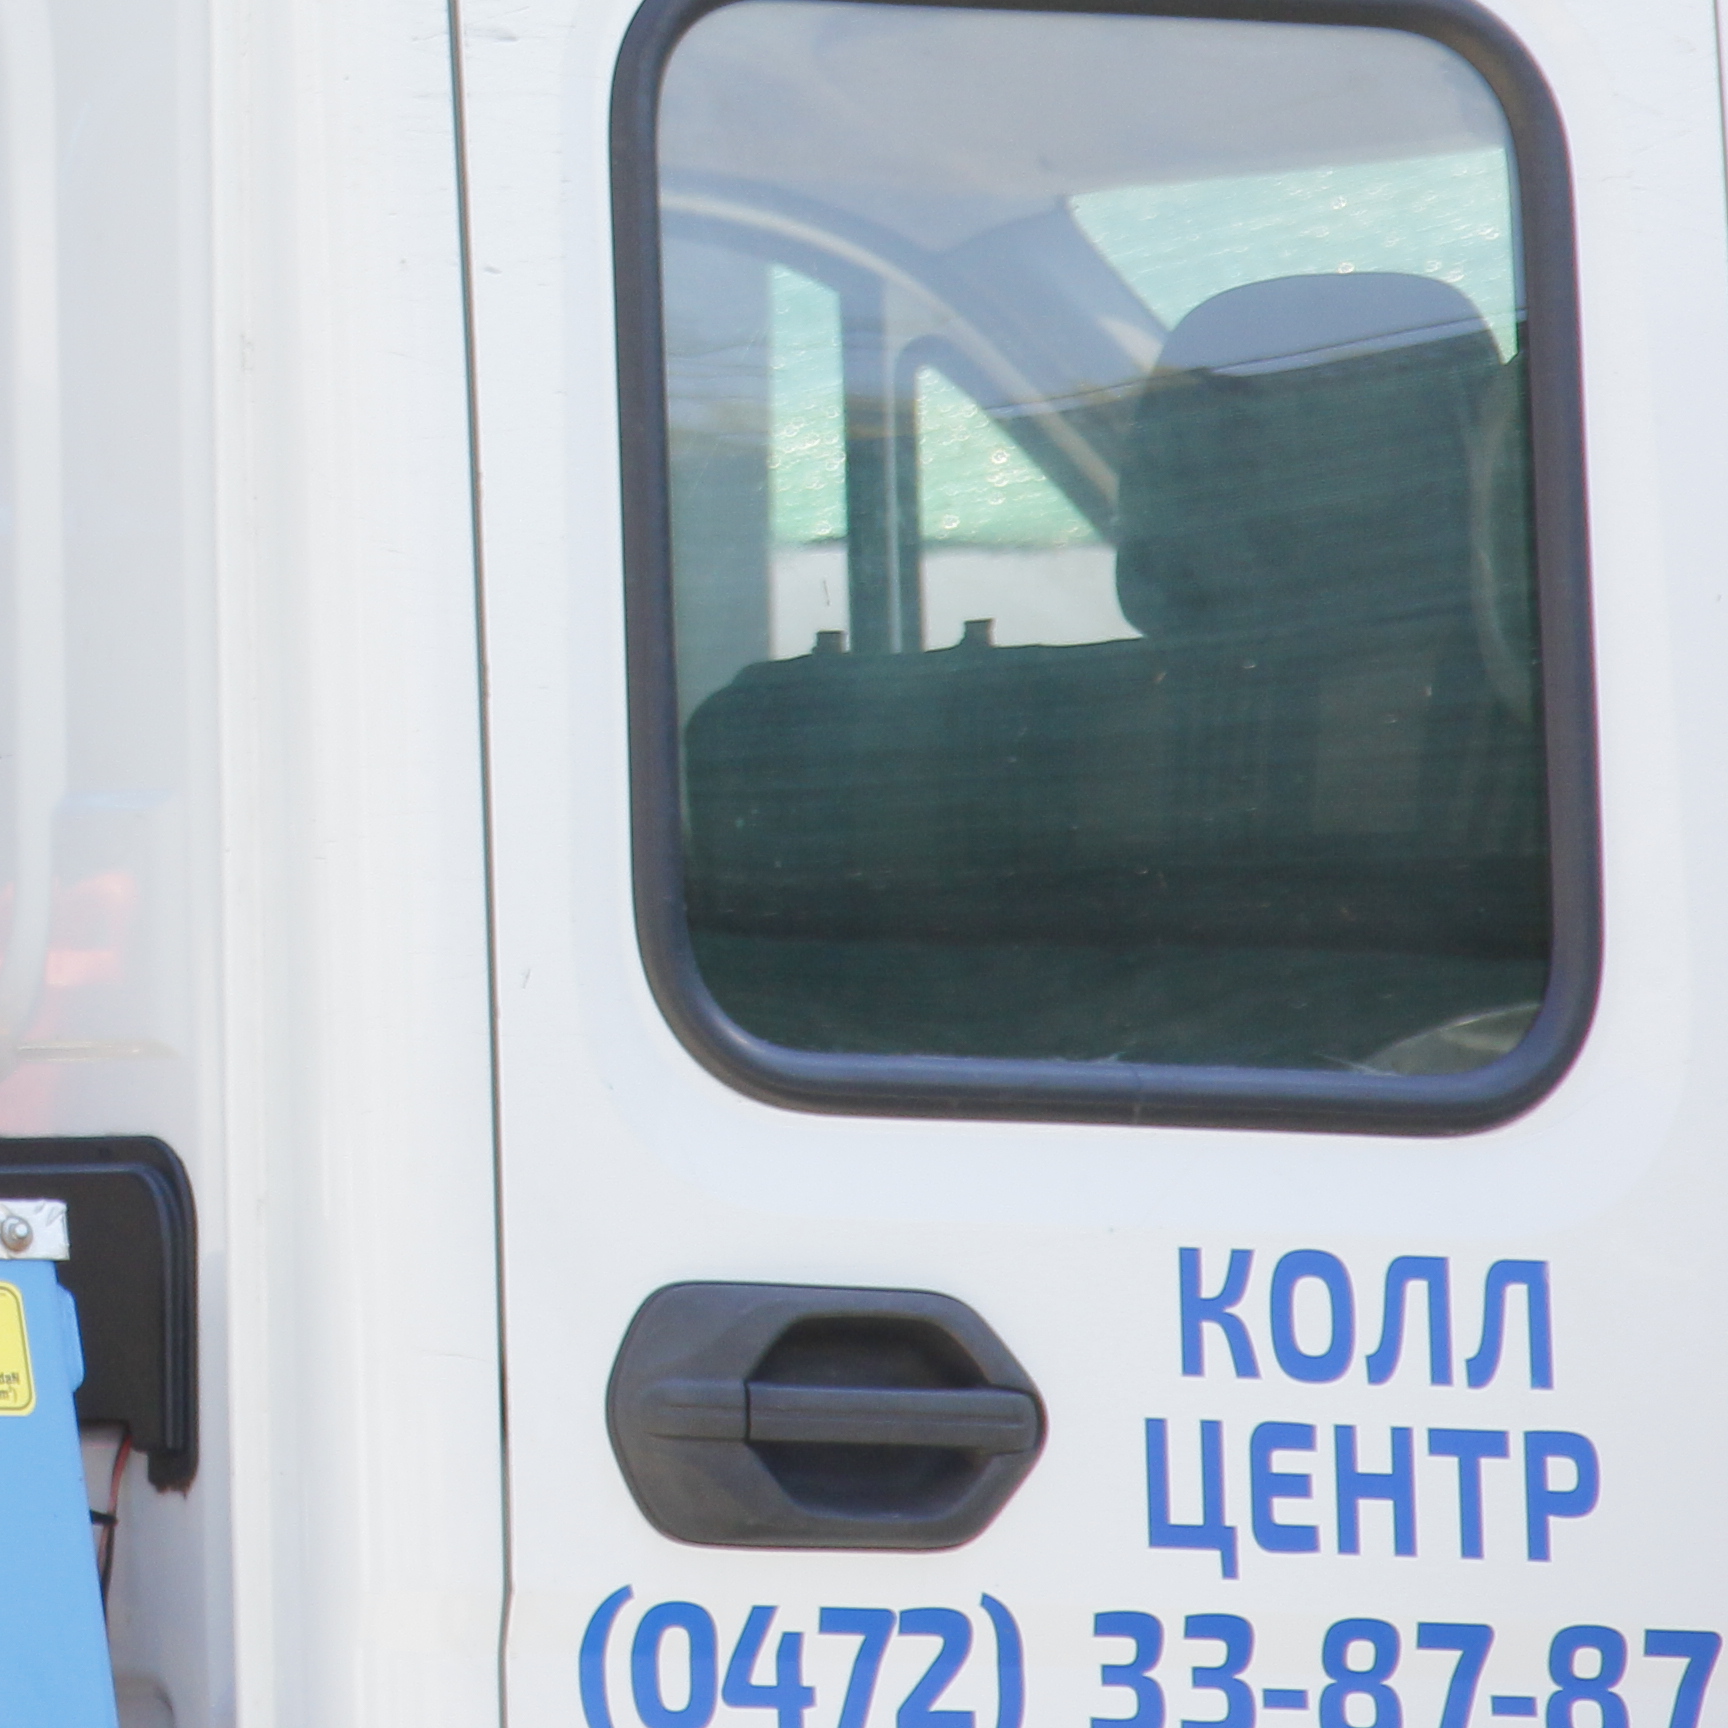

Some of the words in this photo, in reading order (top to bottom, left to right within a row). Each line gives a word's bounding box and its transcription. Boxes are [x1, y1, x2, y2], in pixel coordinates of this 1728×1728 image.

[1178, 1247, 1553, 1390] КОЛЛ
[1145, 1417, 1599, 1579] ЦЕНТР
[578, 1584, 1024, 1728] (0472)
[1089, 1609, 1722, 1728] 33-87-87
